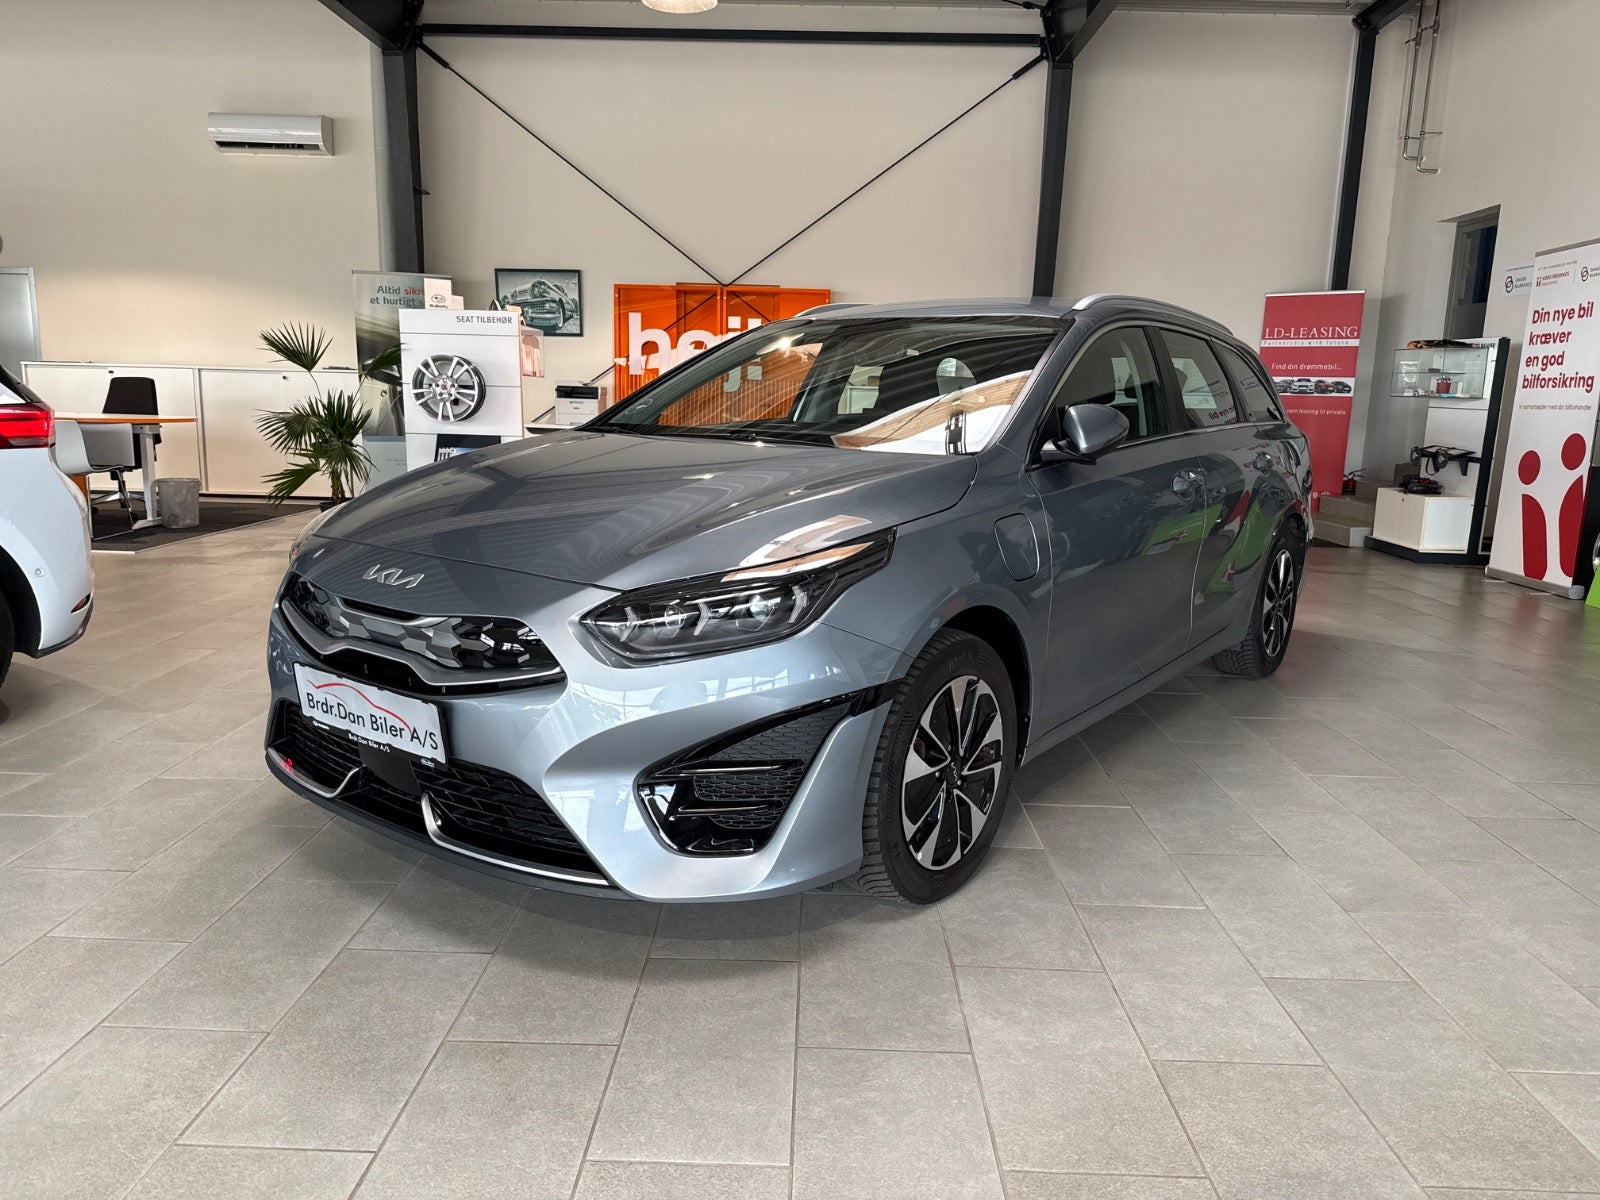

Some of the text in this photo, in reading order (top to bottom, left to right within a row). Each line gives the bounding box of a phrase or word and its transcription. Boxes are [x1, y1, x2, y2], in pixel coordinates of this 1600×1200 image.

[377, 285, 400, 295] Altid
[370, 296, 380, 305] et
[383, 296, 417, 308] hurtigt
[456, 315, 513, 325] SEAT TILBEHØR
[1532, 301, 1595, 326] Din nye bil
[1264, 326, 1359, 339] LD-LEASING
[1528, 330, 1573, 346] kræver
[1525, 350, 1566, 372] en god
[1522, 371, 1595, 394] bilforsikring
[361, 563, 425, 589] KIA
[306, 692, 366, 727] Brdr.Dan
[370, 714, 405, 739] Biler
[410, 726, 439, 750] A/S
